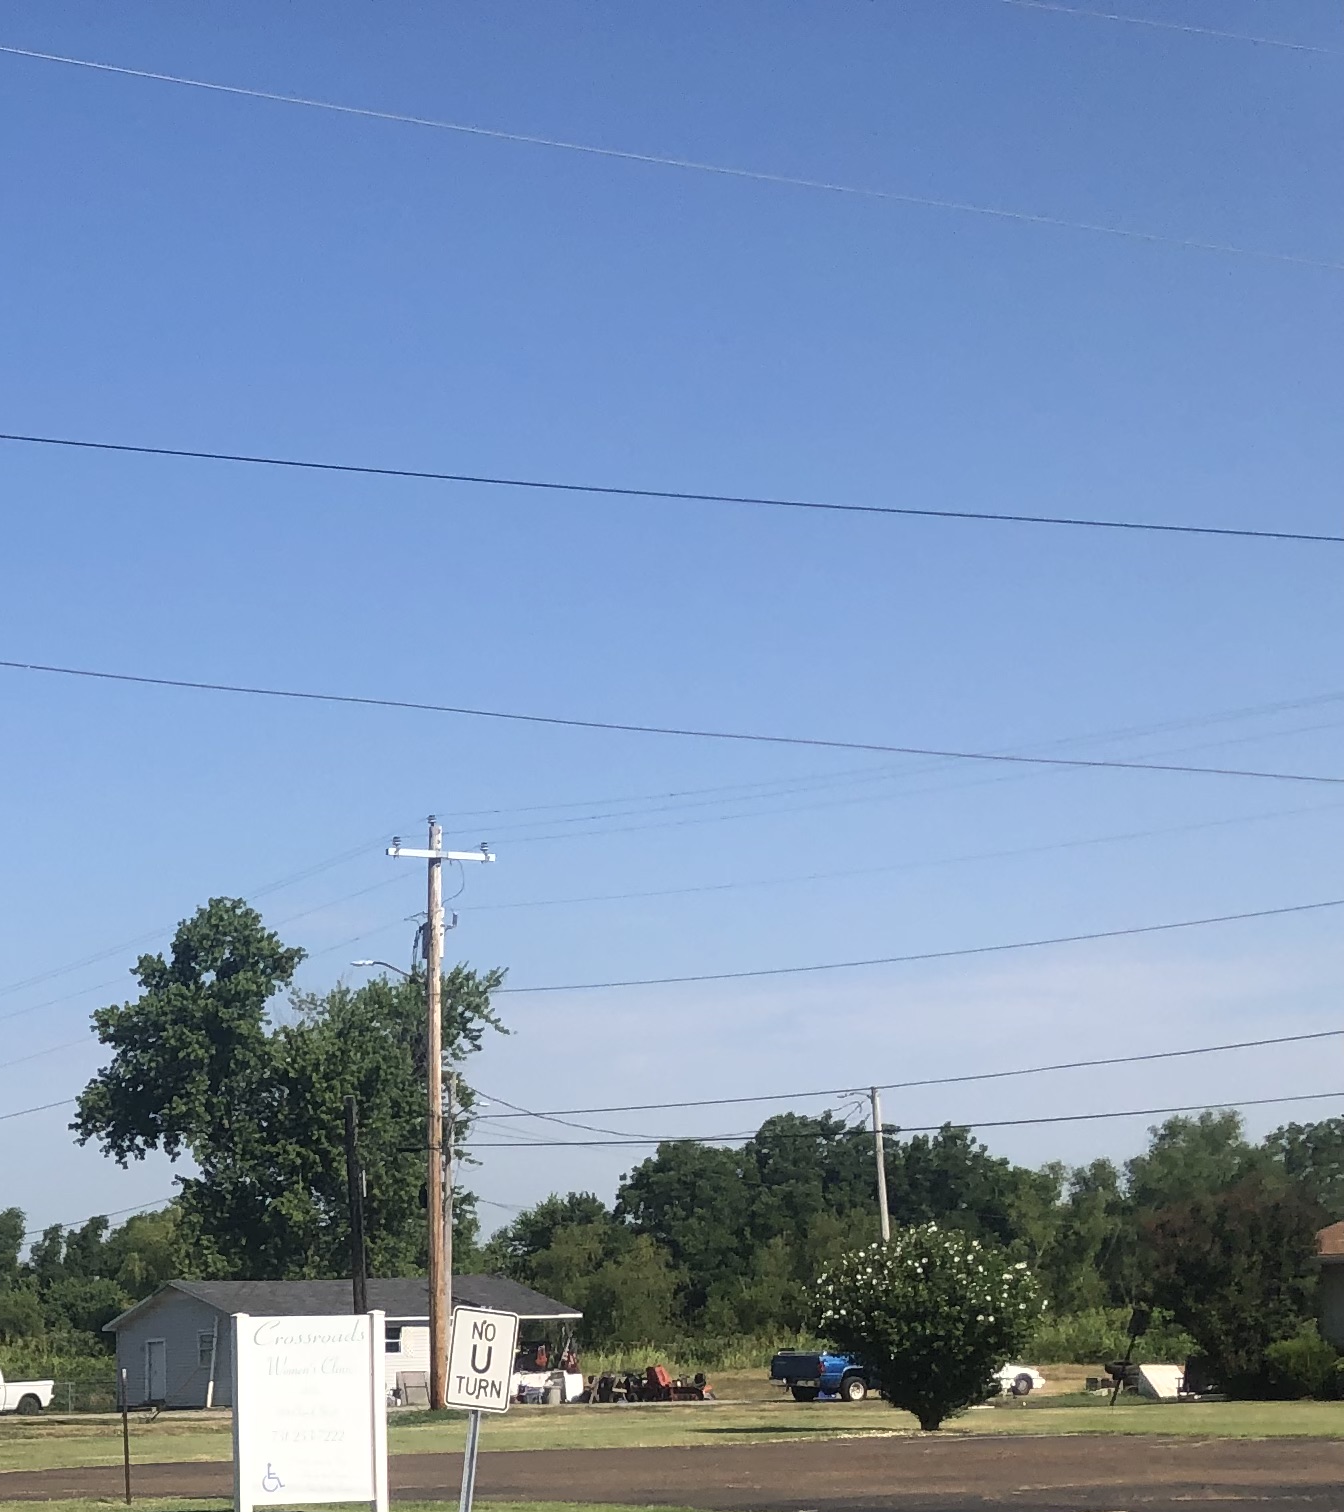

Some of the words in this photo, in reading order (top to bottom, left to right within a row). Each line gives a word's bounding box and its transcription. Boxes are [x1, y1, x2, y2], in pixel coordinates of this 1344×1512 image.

[253, 1318, 365, 1346] Crossroads
[472, 1320, 496, 1342] NO
[470, 1343, 493, 1375] U
[456, 1375, 502, 1400] TURN
